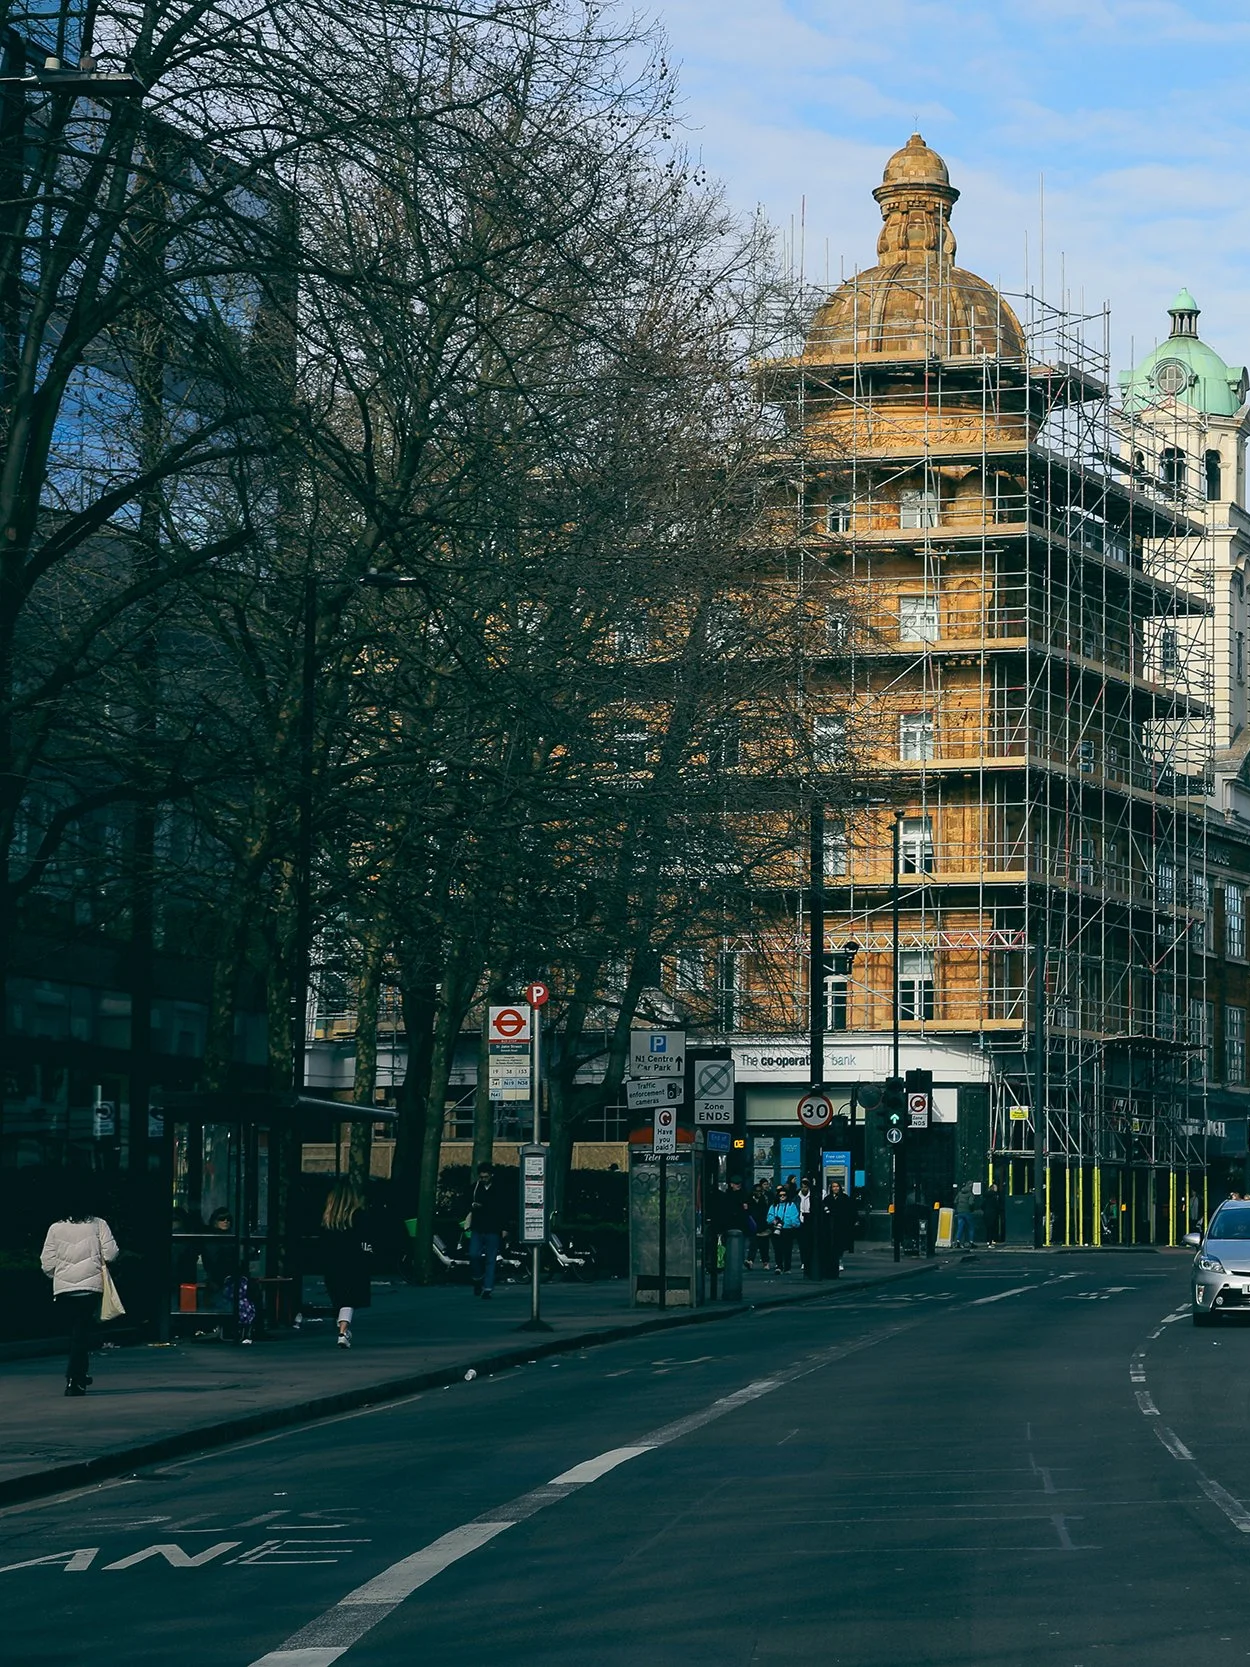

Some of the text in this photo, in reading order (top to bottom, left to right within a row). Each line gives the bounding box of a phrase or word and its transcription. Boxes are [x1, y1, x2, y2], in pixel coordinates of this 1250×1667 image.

[532, 986, 544, 1003] P
[653, 1037, 664, 1051] P
[741, 1054, 856, 1068] The co-operat bank
[637, 1082, 656, 1090] Traffic
[629, 1089, 665, 1099] enforcement
[699, 1112, 730, 1121] ENDS
[802, 1104, 829, 1119] 30
